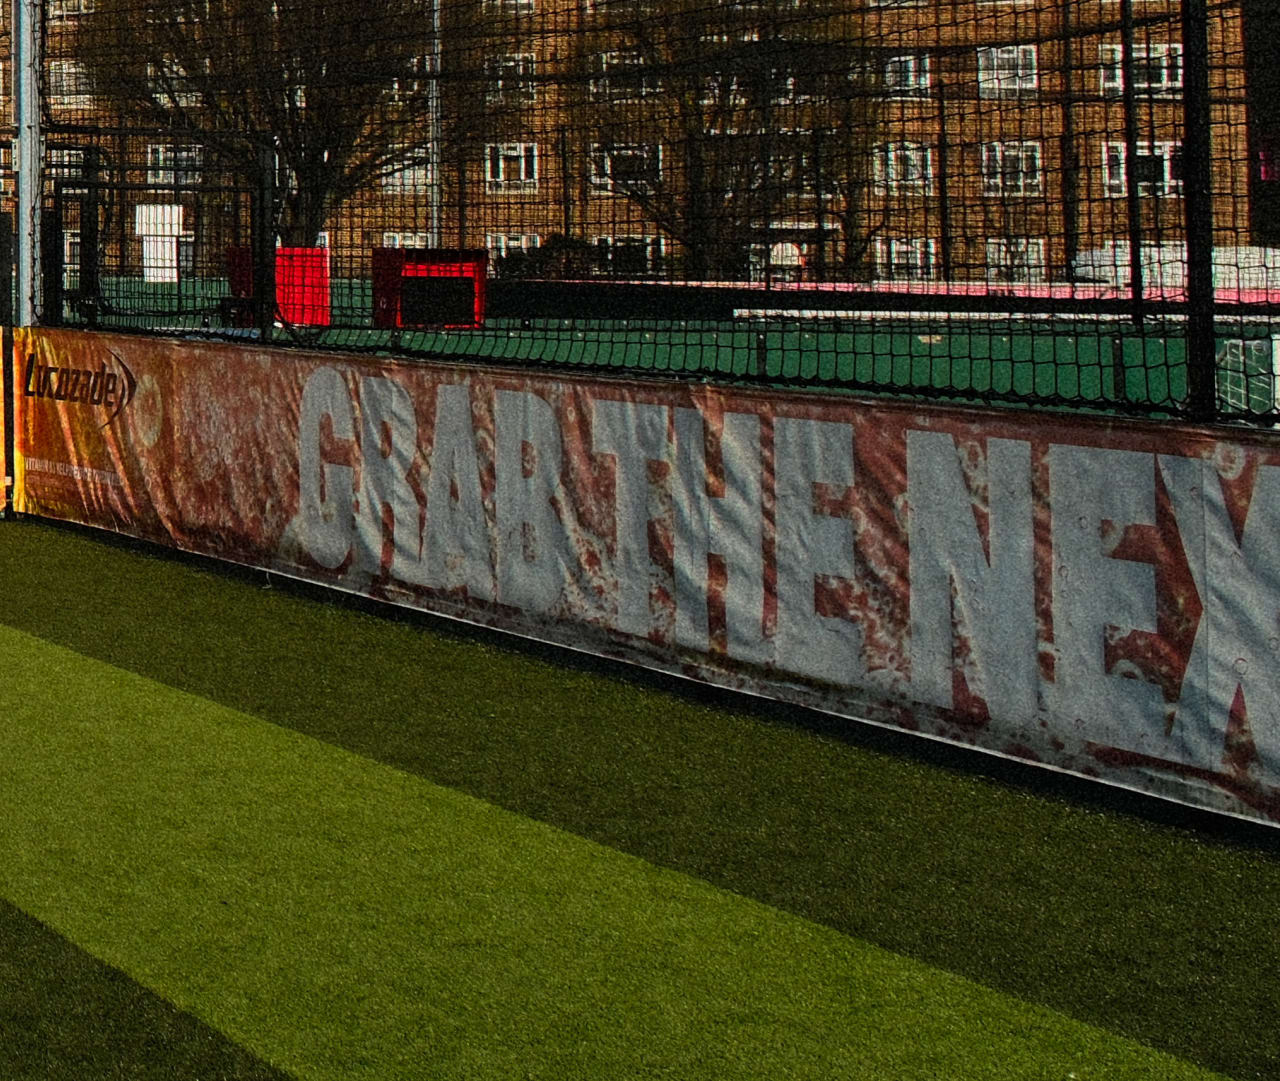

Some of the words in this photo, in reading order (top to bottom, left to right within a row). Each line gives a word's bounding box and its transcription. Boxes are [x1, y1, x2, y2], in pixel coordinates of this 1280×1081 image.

[23, 353, 118, 407] Lucozade
[299, 363, 564, 610] GRAB
[591, 398, 866, 686] THE
